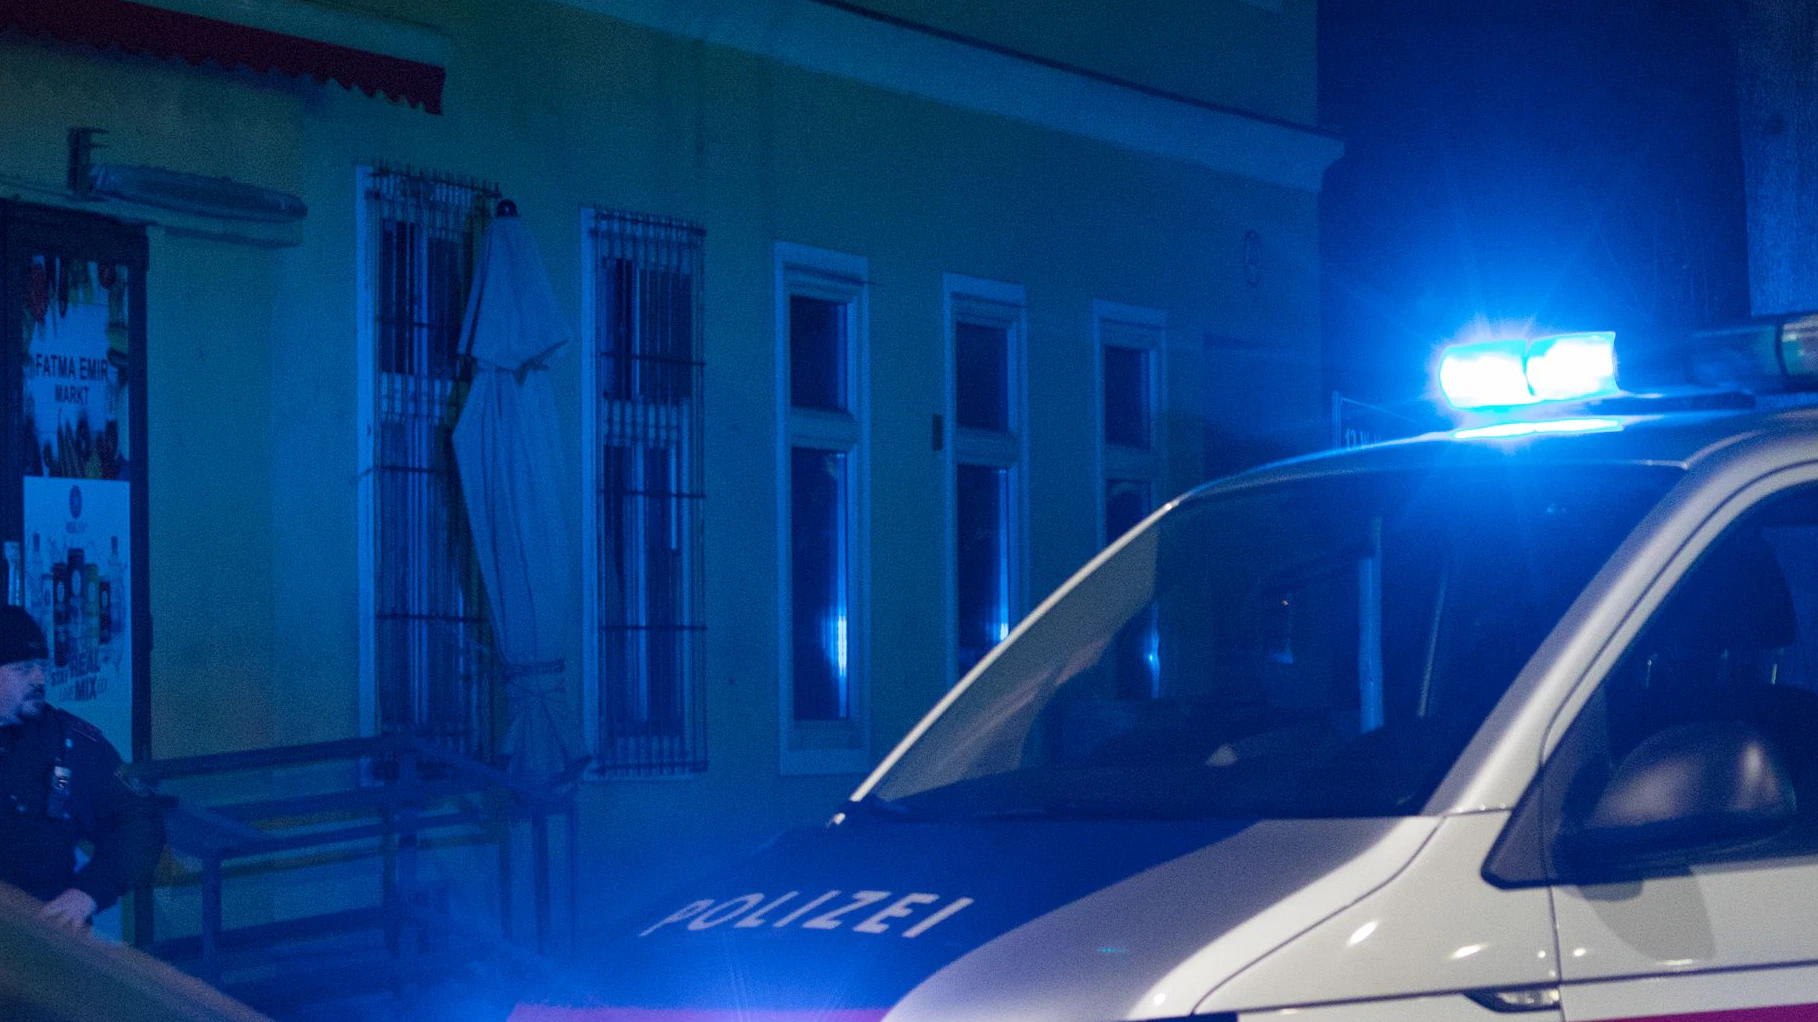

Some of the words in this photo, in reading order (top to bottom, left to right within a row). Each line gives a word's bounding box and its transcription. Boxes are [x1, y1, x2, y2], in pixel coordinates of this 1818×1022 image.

[36, 353, 76, 378] FATMA
[80, 357, 108, 380] EMIR
[55, 384, 89, 404] MARKT
[639, 890, 975, 938] POLIZEI
